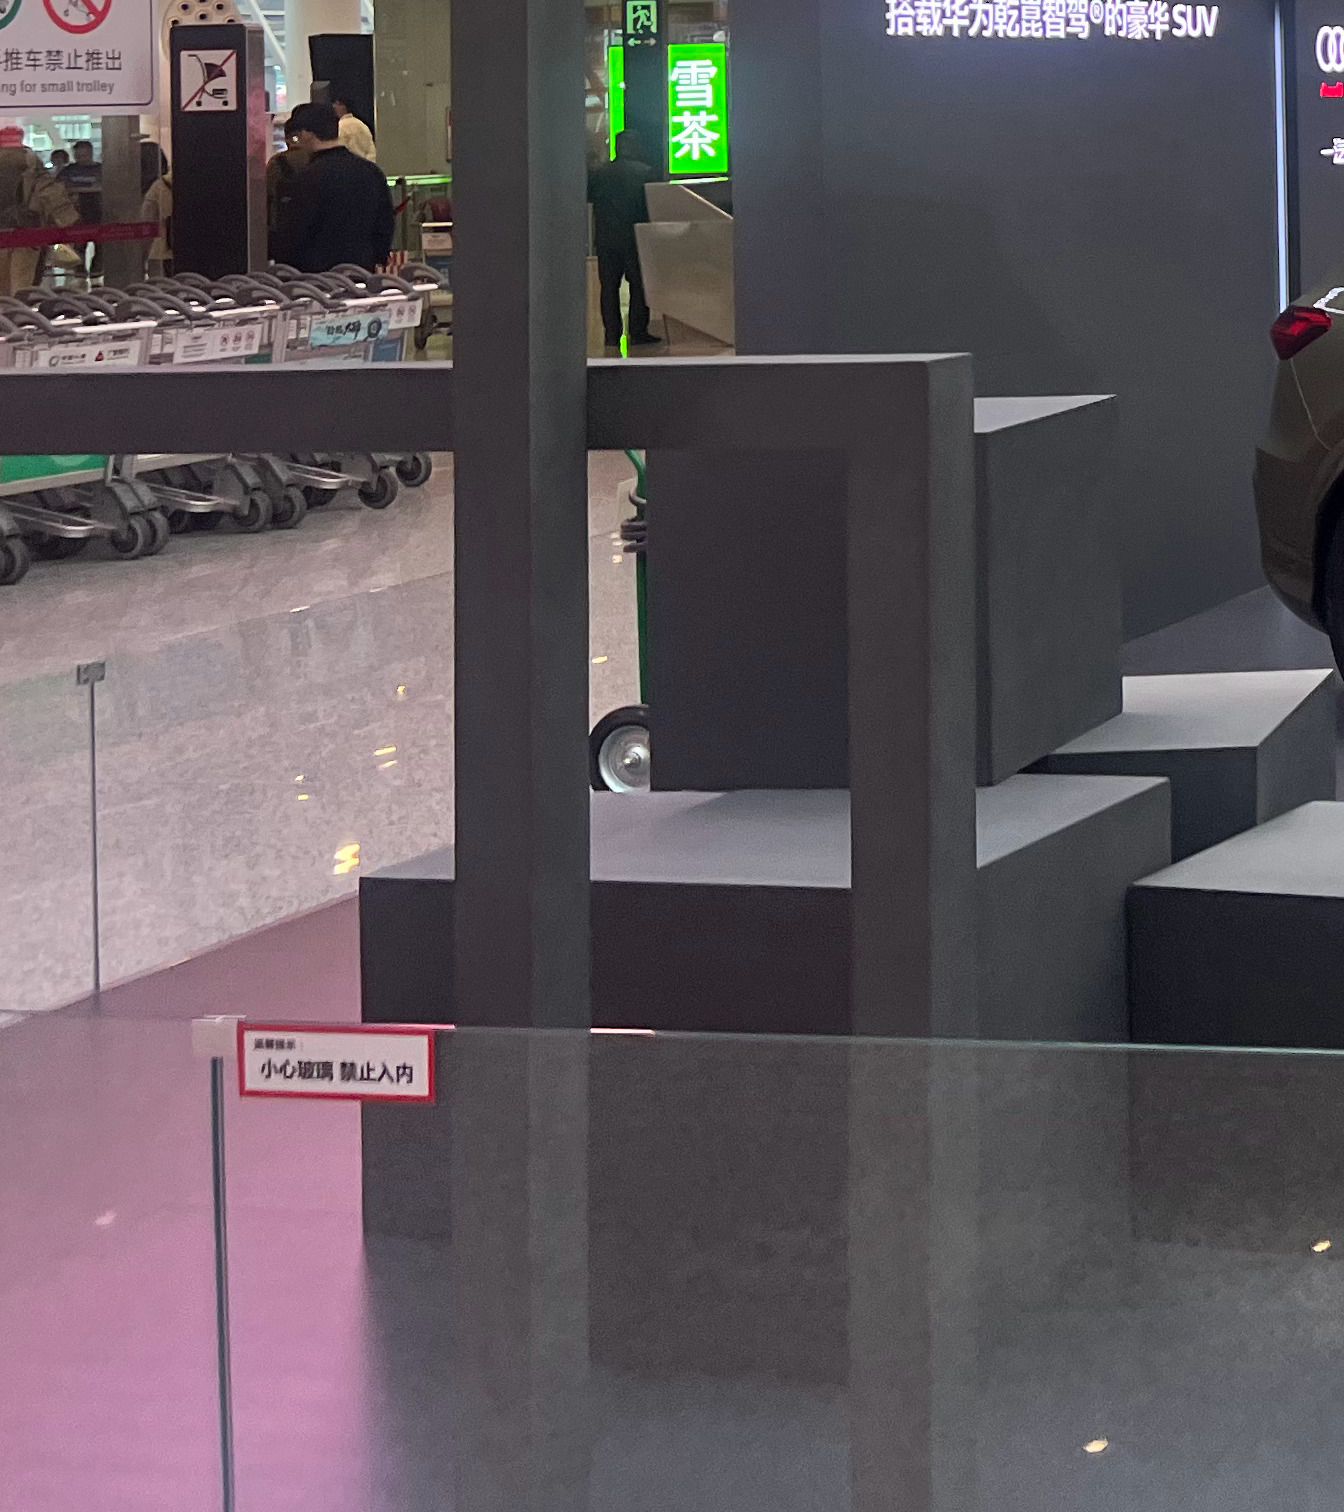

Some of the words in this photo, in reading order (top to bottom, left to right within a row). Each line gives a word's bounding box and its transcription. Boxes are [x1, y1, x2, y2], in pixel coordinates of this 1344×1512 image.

[1172, 4, 1219, 38] SUV
[0, 47, 123, 72] 推车禁止推出
[20, 79, 37, 93] for
[41, 80, 73, 93] small
[76, 80, 115, 95] trolley
[668, 58, 721, 161] 雪茶
